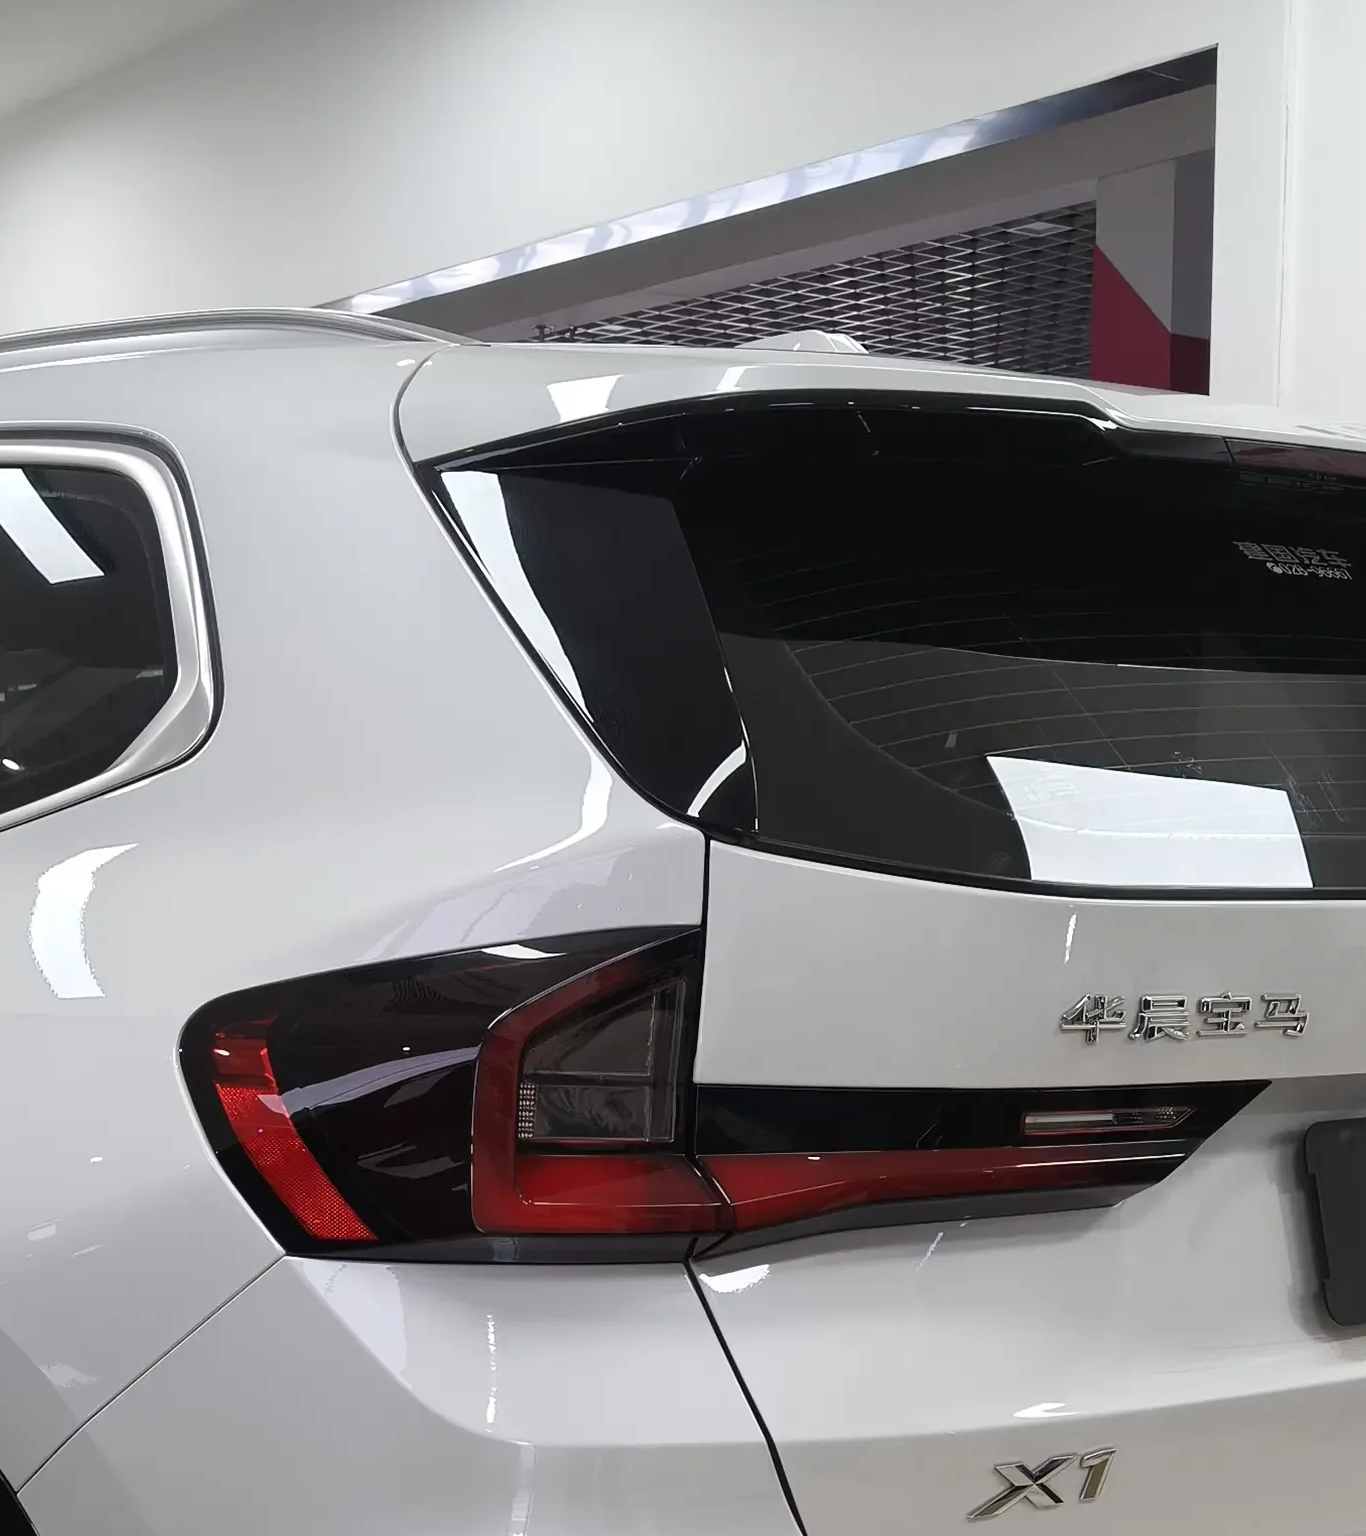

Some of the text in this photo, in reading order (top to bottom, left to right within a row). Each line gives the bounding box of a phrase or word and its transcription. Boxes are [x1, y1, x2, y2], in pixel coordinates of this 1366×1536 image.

[1059, 993, 1311, 1043] 华晨宝马
[967, 1447, 1117, 1520] X1
